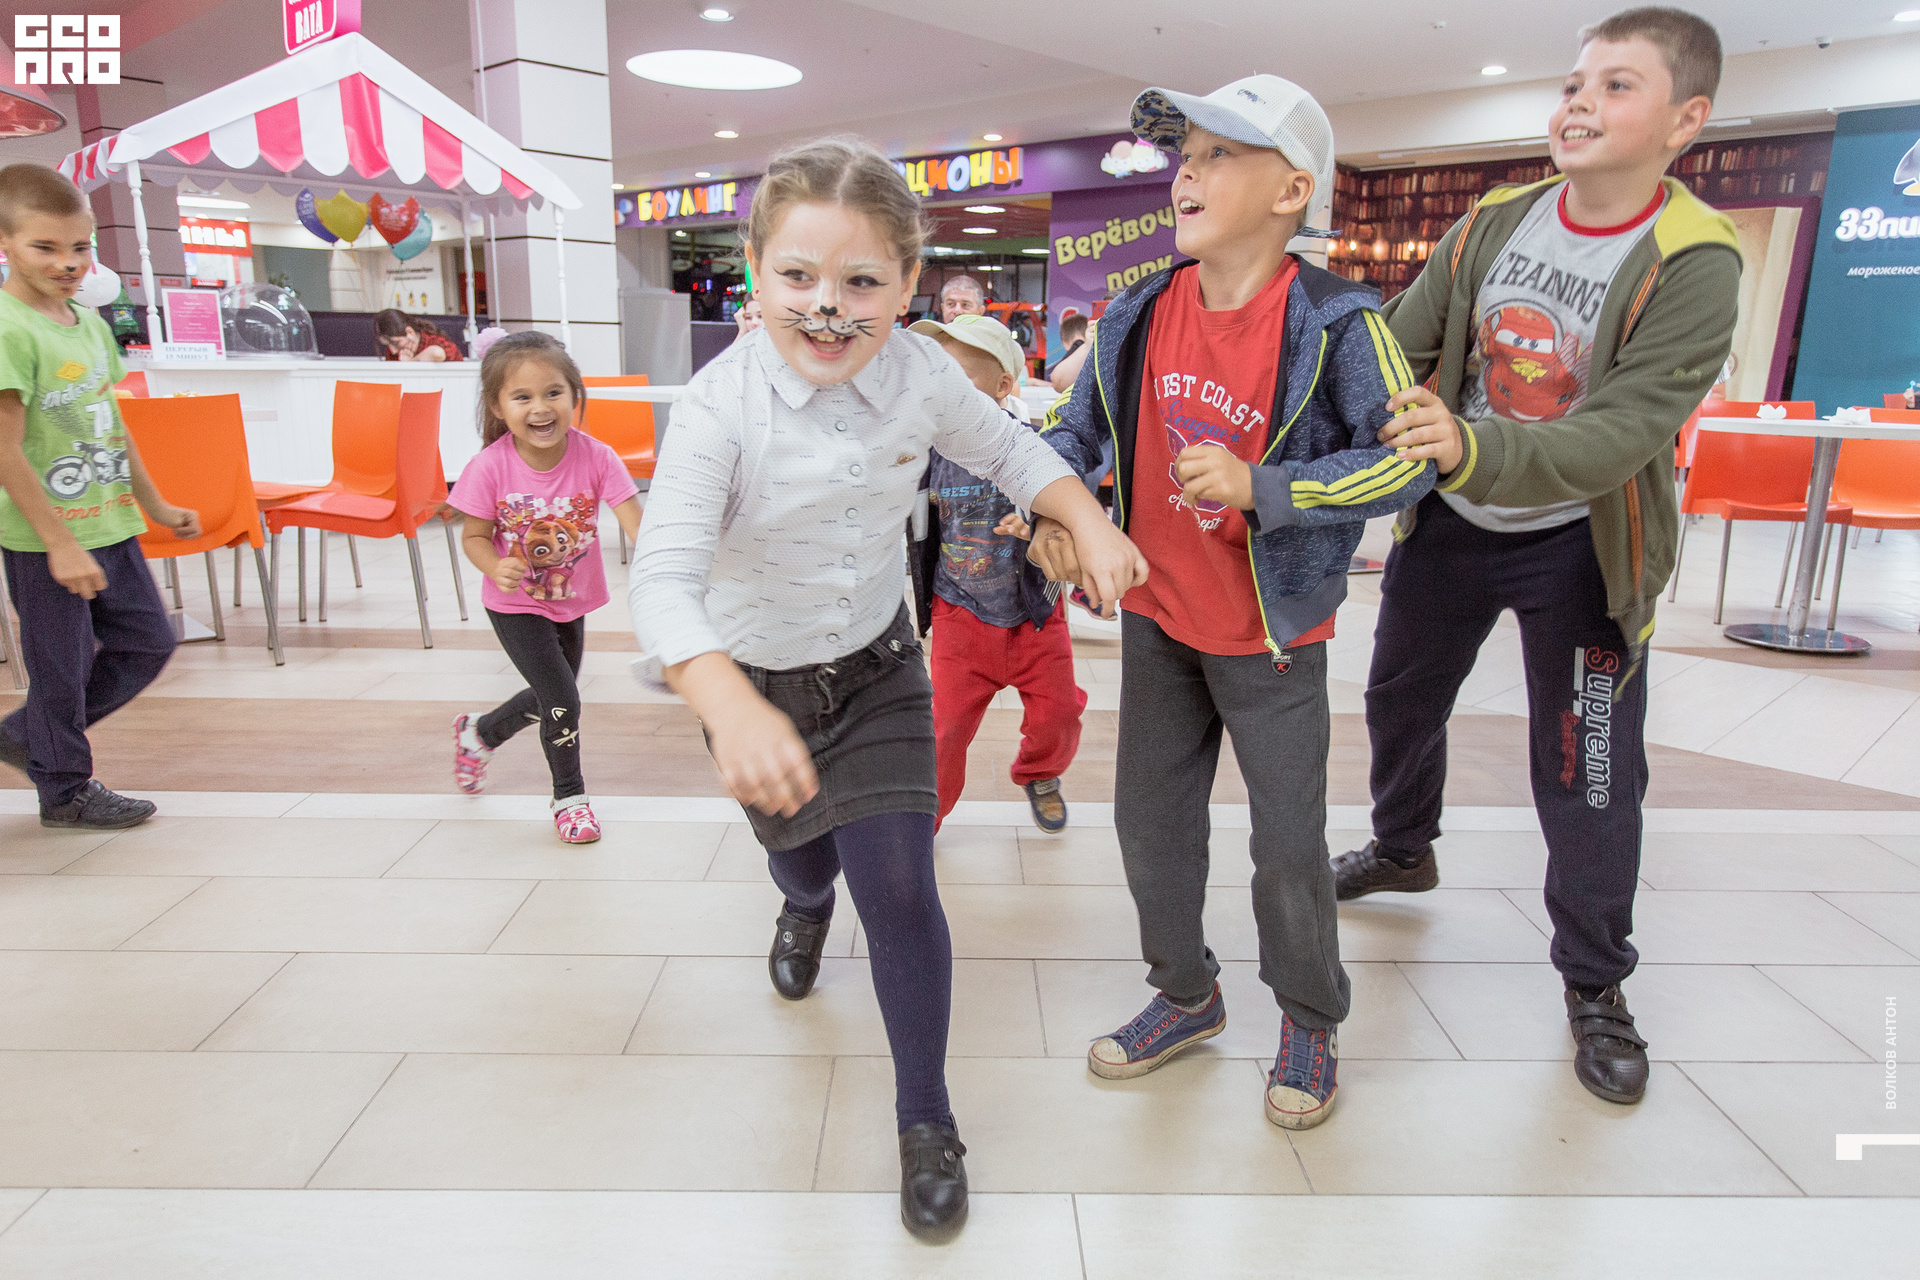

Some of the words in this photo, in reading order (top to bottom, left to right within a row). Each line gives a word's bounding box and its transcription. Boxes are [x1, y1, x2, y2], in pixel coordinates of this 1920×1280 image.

[295, 0, 324, 44] ВАТА
[893, 147, 1021, 197] ЦИОНЫ
[637, 182, 736, 221] БОУЛИНГ
[1055, 206, 1175, 266] Верёвоч
[1835, 206, 1920, 242] 33пи
[1487, 252, 1607, 325] TRAINING
[1847, 266, 1920, 279] мороженое
[1153, 372, 1197, 401] EST
[1200, 380, 1265, 433] COAST
[1160, 398, 1229, 442] League
[940, 484, 984, 498] BEST
[1579, 646, 1619, 809] Supreme
